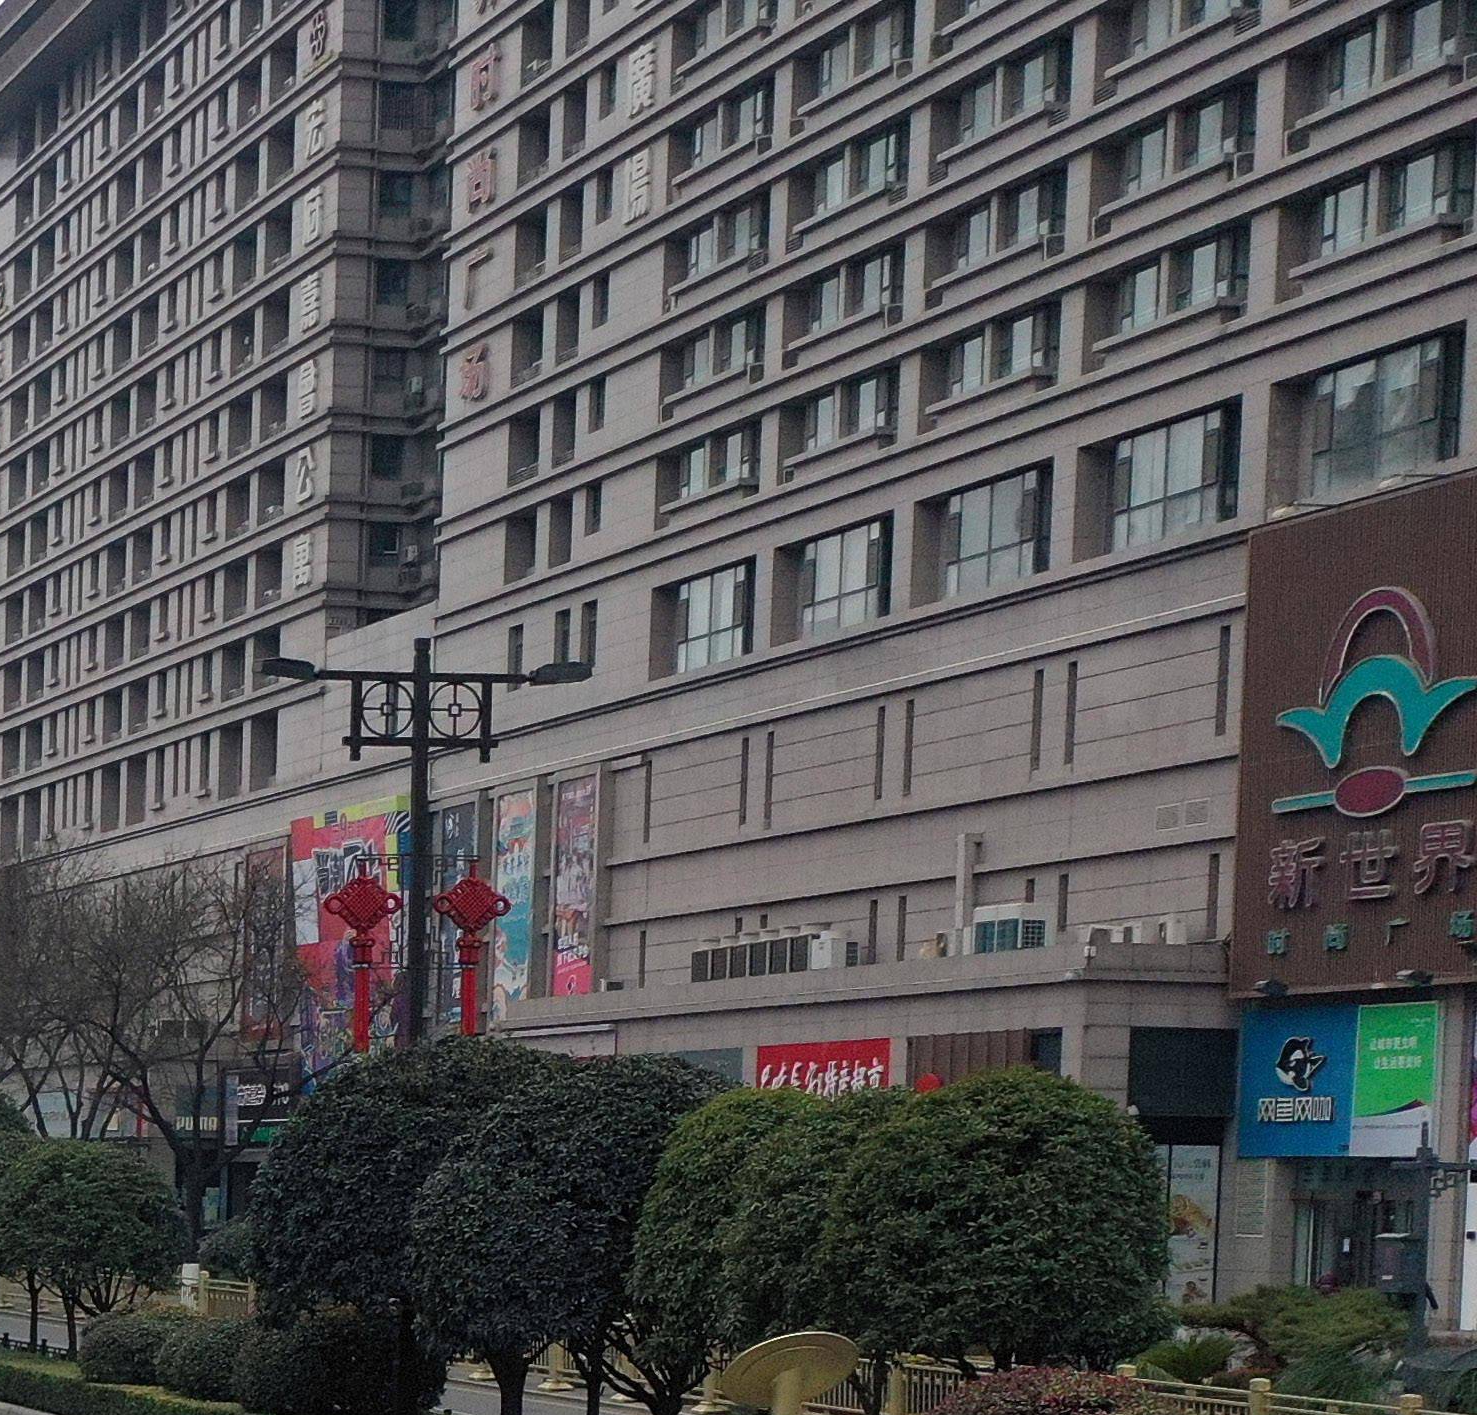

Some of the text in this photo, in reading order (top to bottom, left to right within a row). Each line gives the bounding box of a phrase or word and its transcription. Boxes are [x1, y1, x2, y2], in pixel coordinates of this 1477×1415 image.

[458, 0, 502, 402] 时尚广场
[1267, 818, 1477, 908] 新世界
[1257, 1096, 1335, 1122] 网鱼网咖
